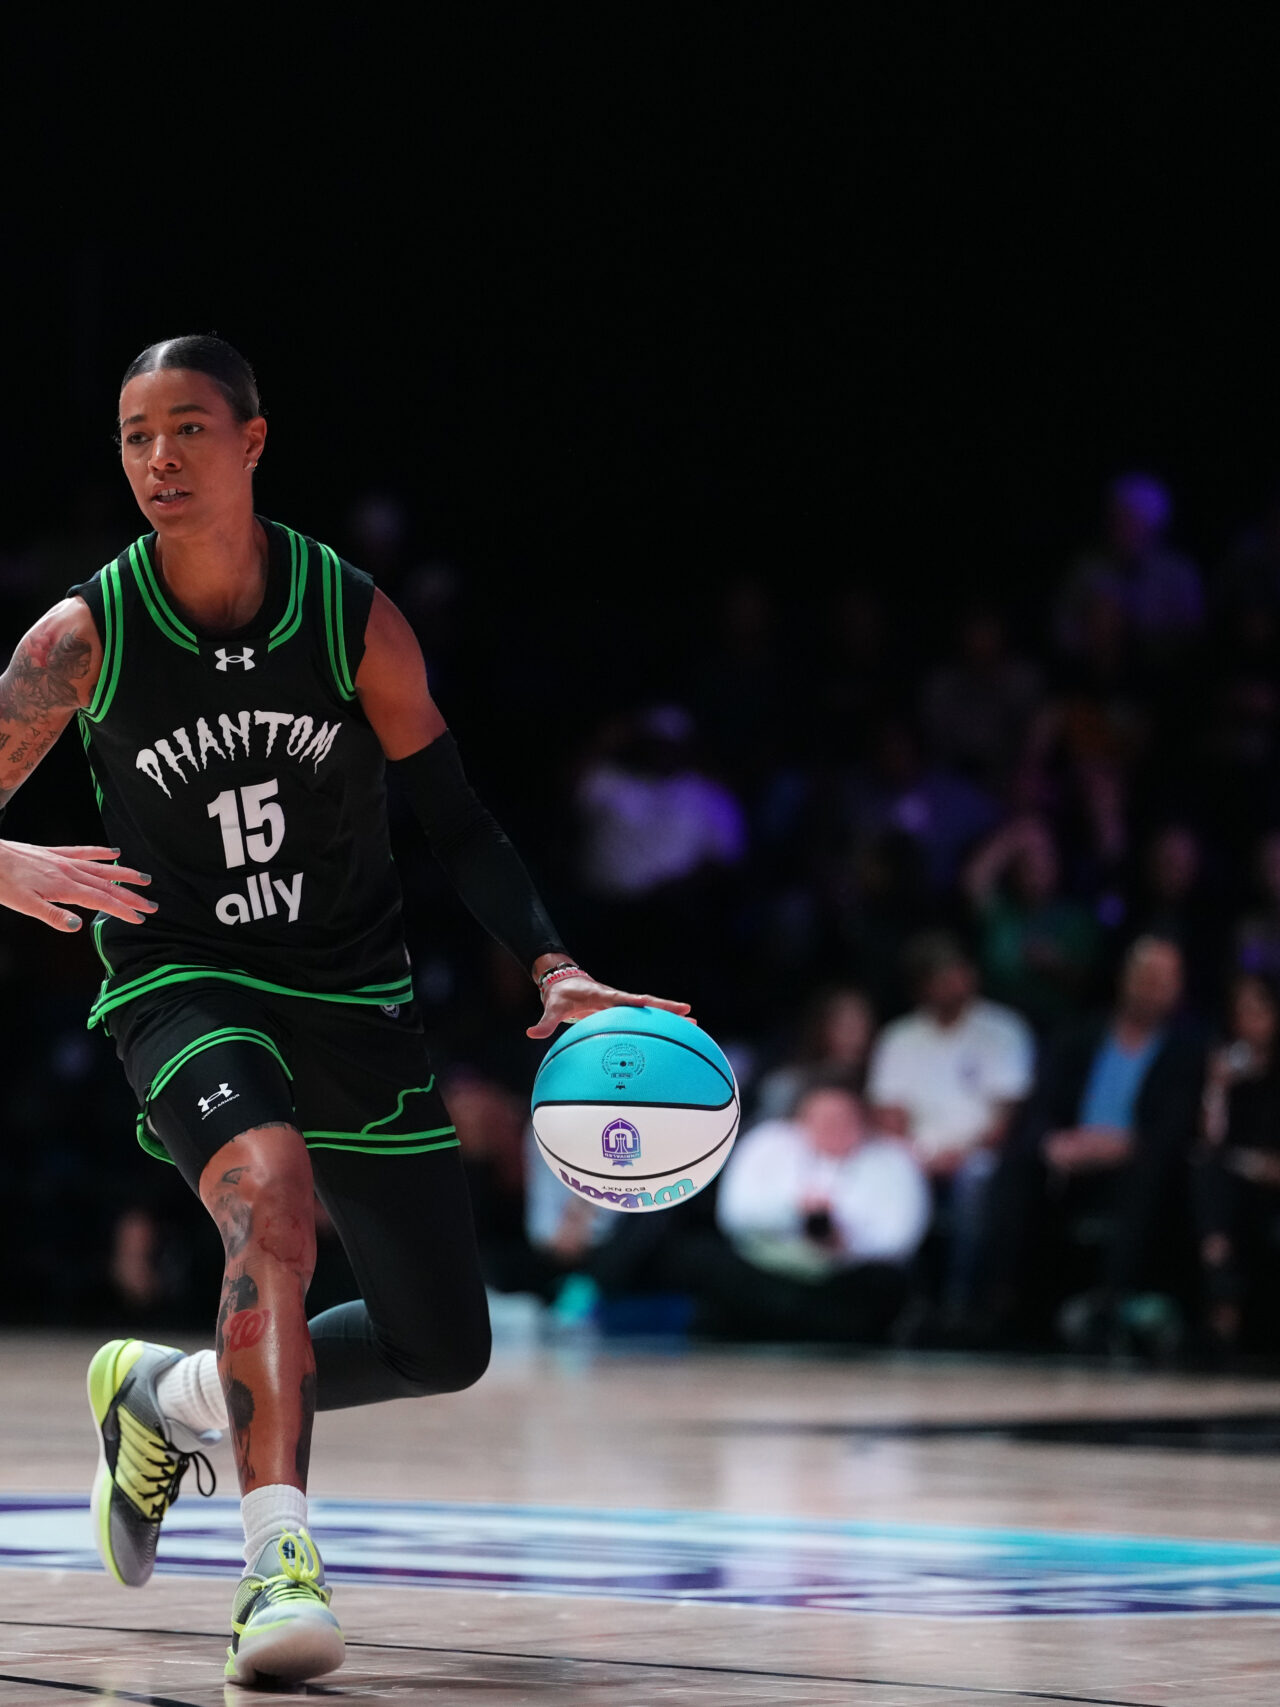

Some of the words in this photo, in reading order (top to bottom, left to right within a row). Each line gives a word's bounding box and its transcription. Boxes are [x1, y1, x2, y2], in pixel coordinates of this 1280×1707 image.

[136, 710, 342, 799] PHANTOM
[207, 778, 286, 869] 15
[215, 871, 304, 925] ally
[602, 1185, 622, 1193] NXT
